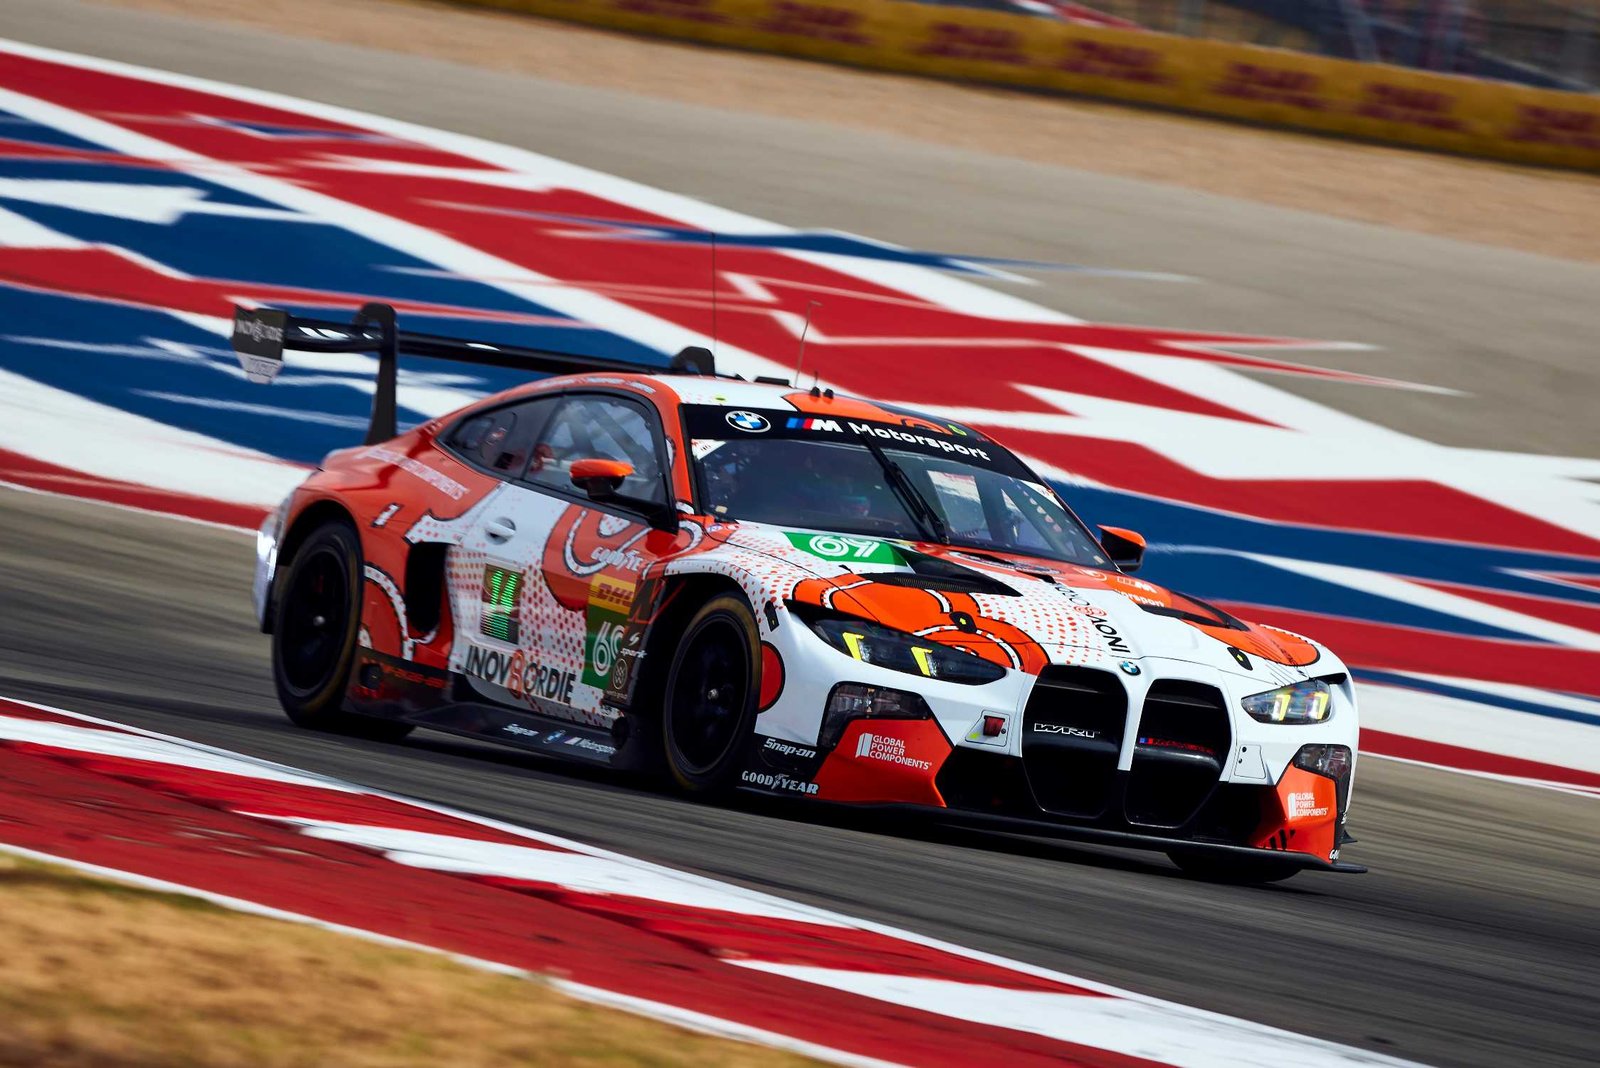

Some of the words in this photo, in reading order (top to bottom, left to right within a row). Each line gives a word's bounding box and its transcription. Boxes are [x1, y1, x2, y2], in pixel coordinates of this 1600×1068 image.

[847, 422, 991, 462] Motorsport
[466, 644, 577, 708] INOV8ORDIE
[1033, 722, 1101, 739] WRT
[763, 737, 817, 758] Snap-on
[870, 742, 905, 757] POWER
[872, 735, 906, 749] GLOBAL
[869, 750, 930, 770] COMPONENTS
[741, 770, 819, 794] GOODYEAR
[1295, 792, 1315, 800] GLOBAL
[1295, 800, 1316, 808] POWER
[1295, 807, 1328, 817] COMPONENTS
